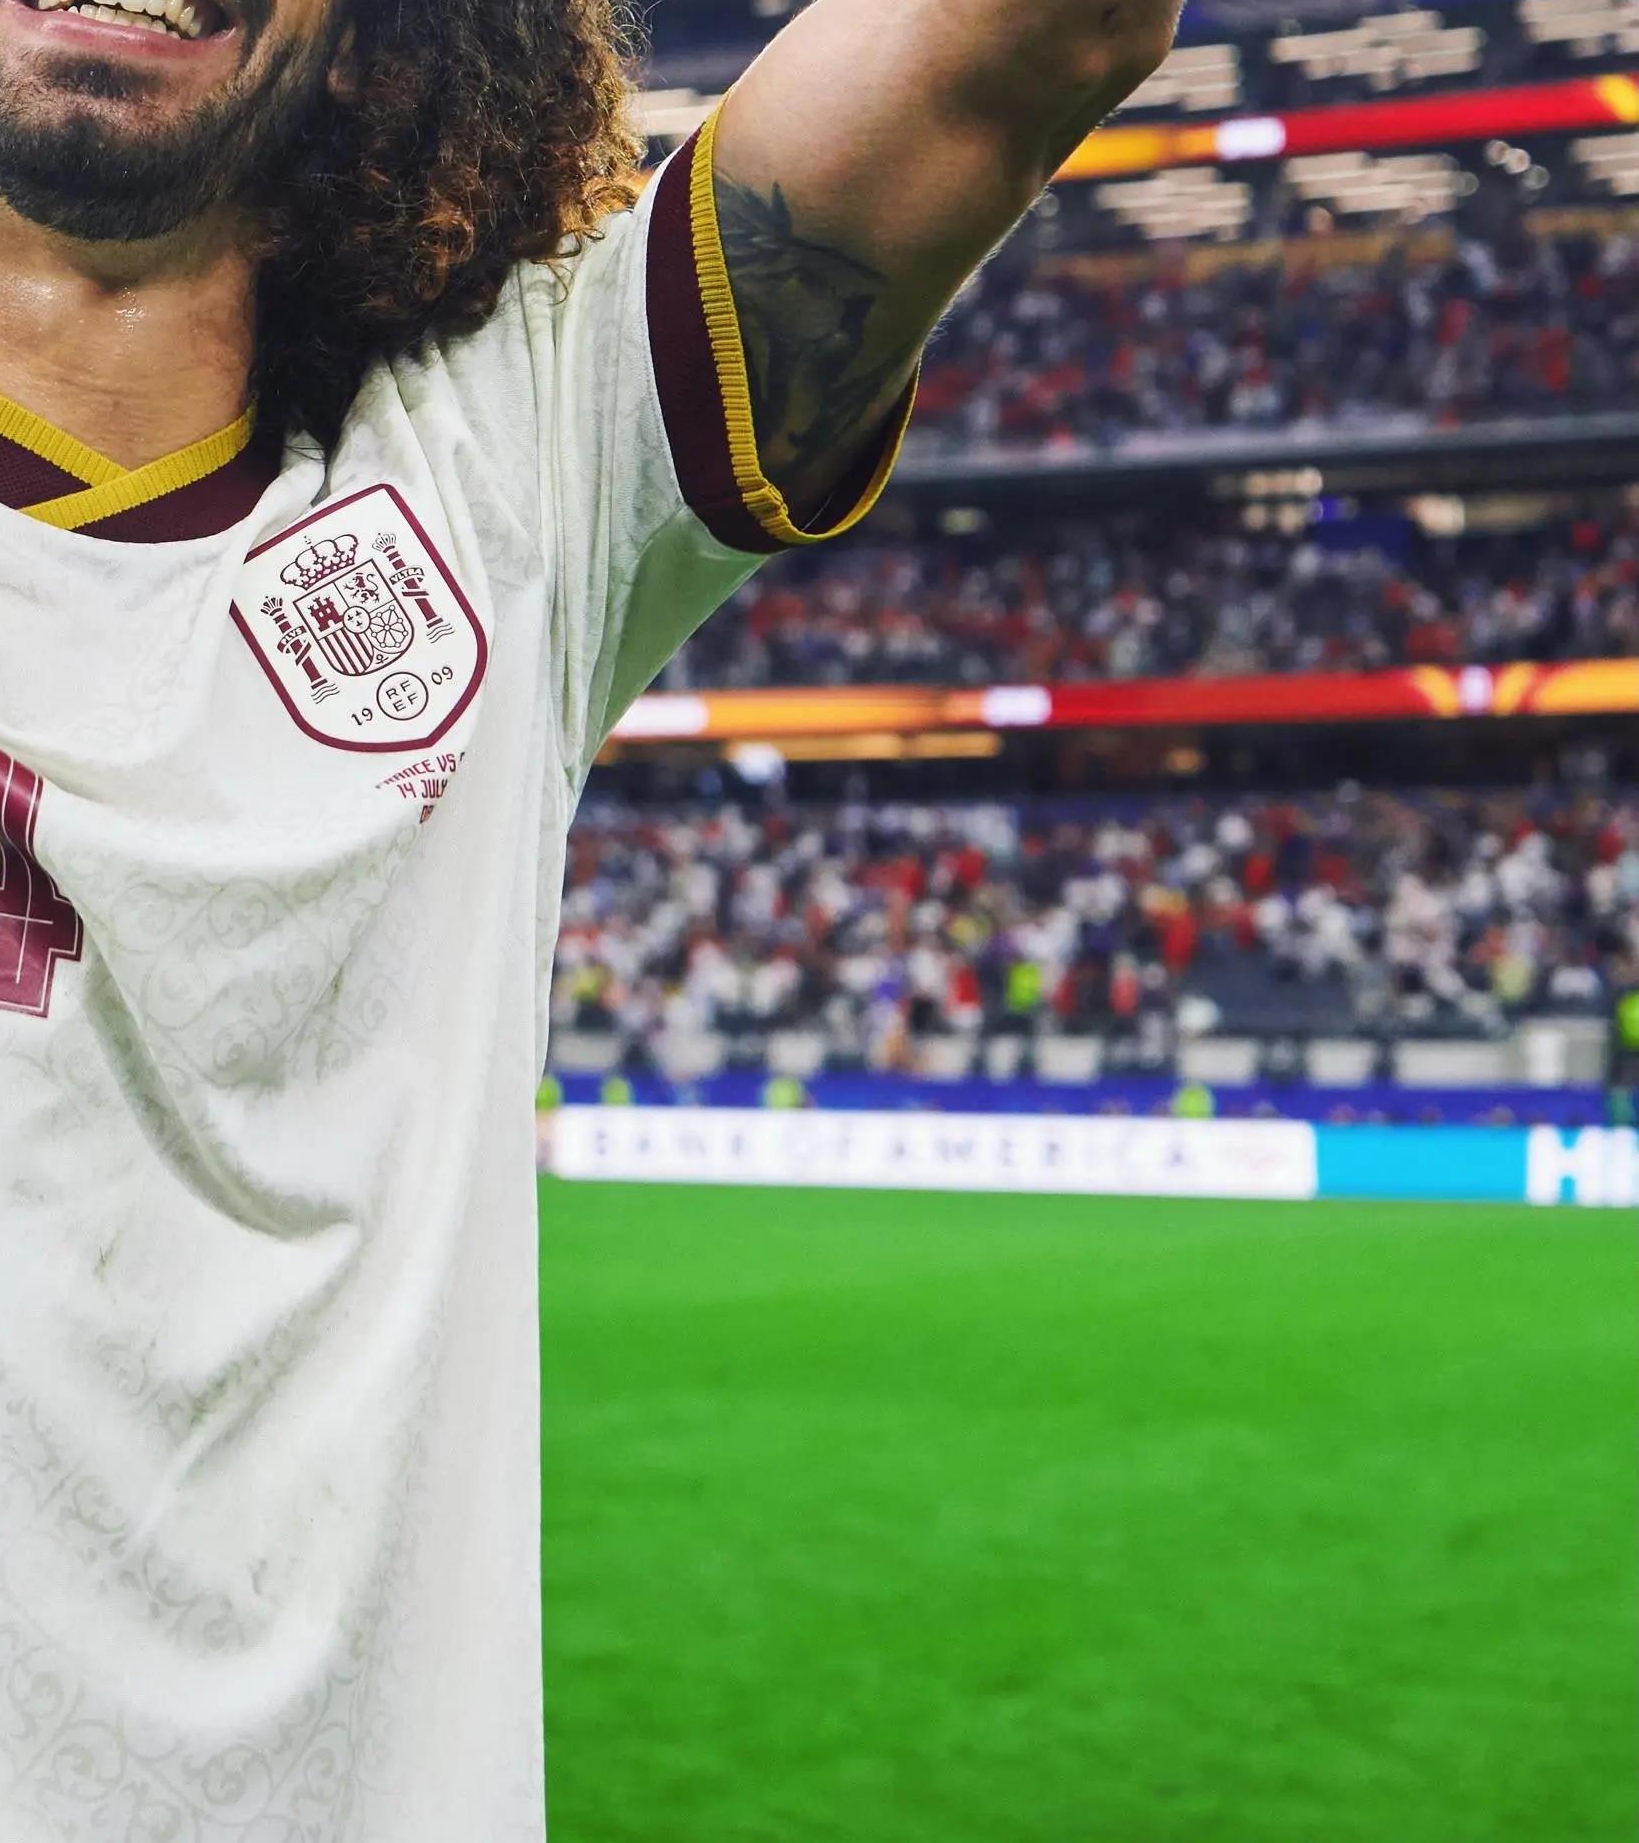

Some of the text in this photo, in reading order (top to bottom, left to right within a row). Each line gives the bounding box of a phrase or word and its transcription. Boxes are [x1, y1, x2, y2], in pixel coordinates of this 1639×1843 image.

[351, 666, 453, 726] 19 09
[375, 759, 435, 789] RANCE
[436, 753, 456, 772] VS
[396, 780, 417, 799] 14
